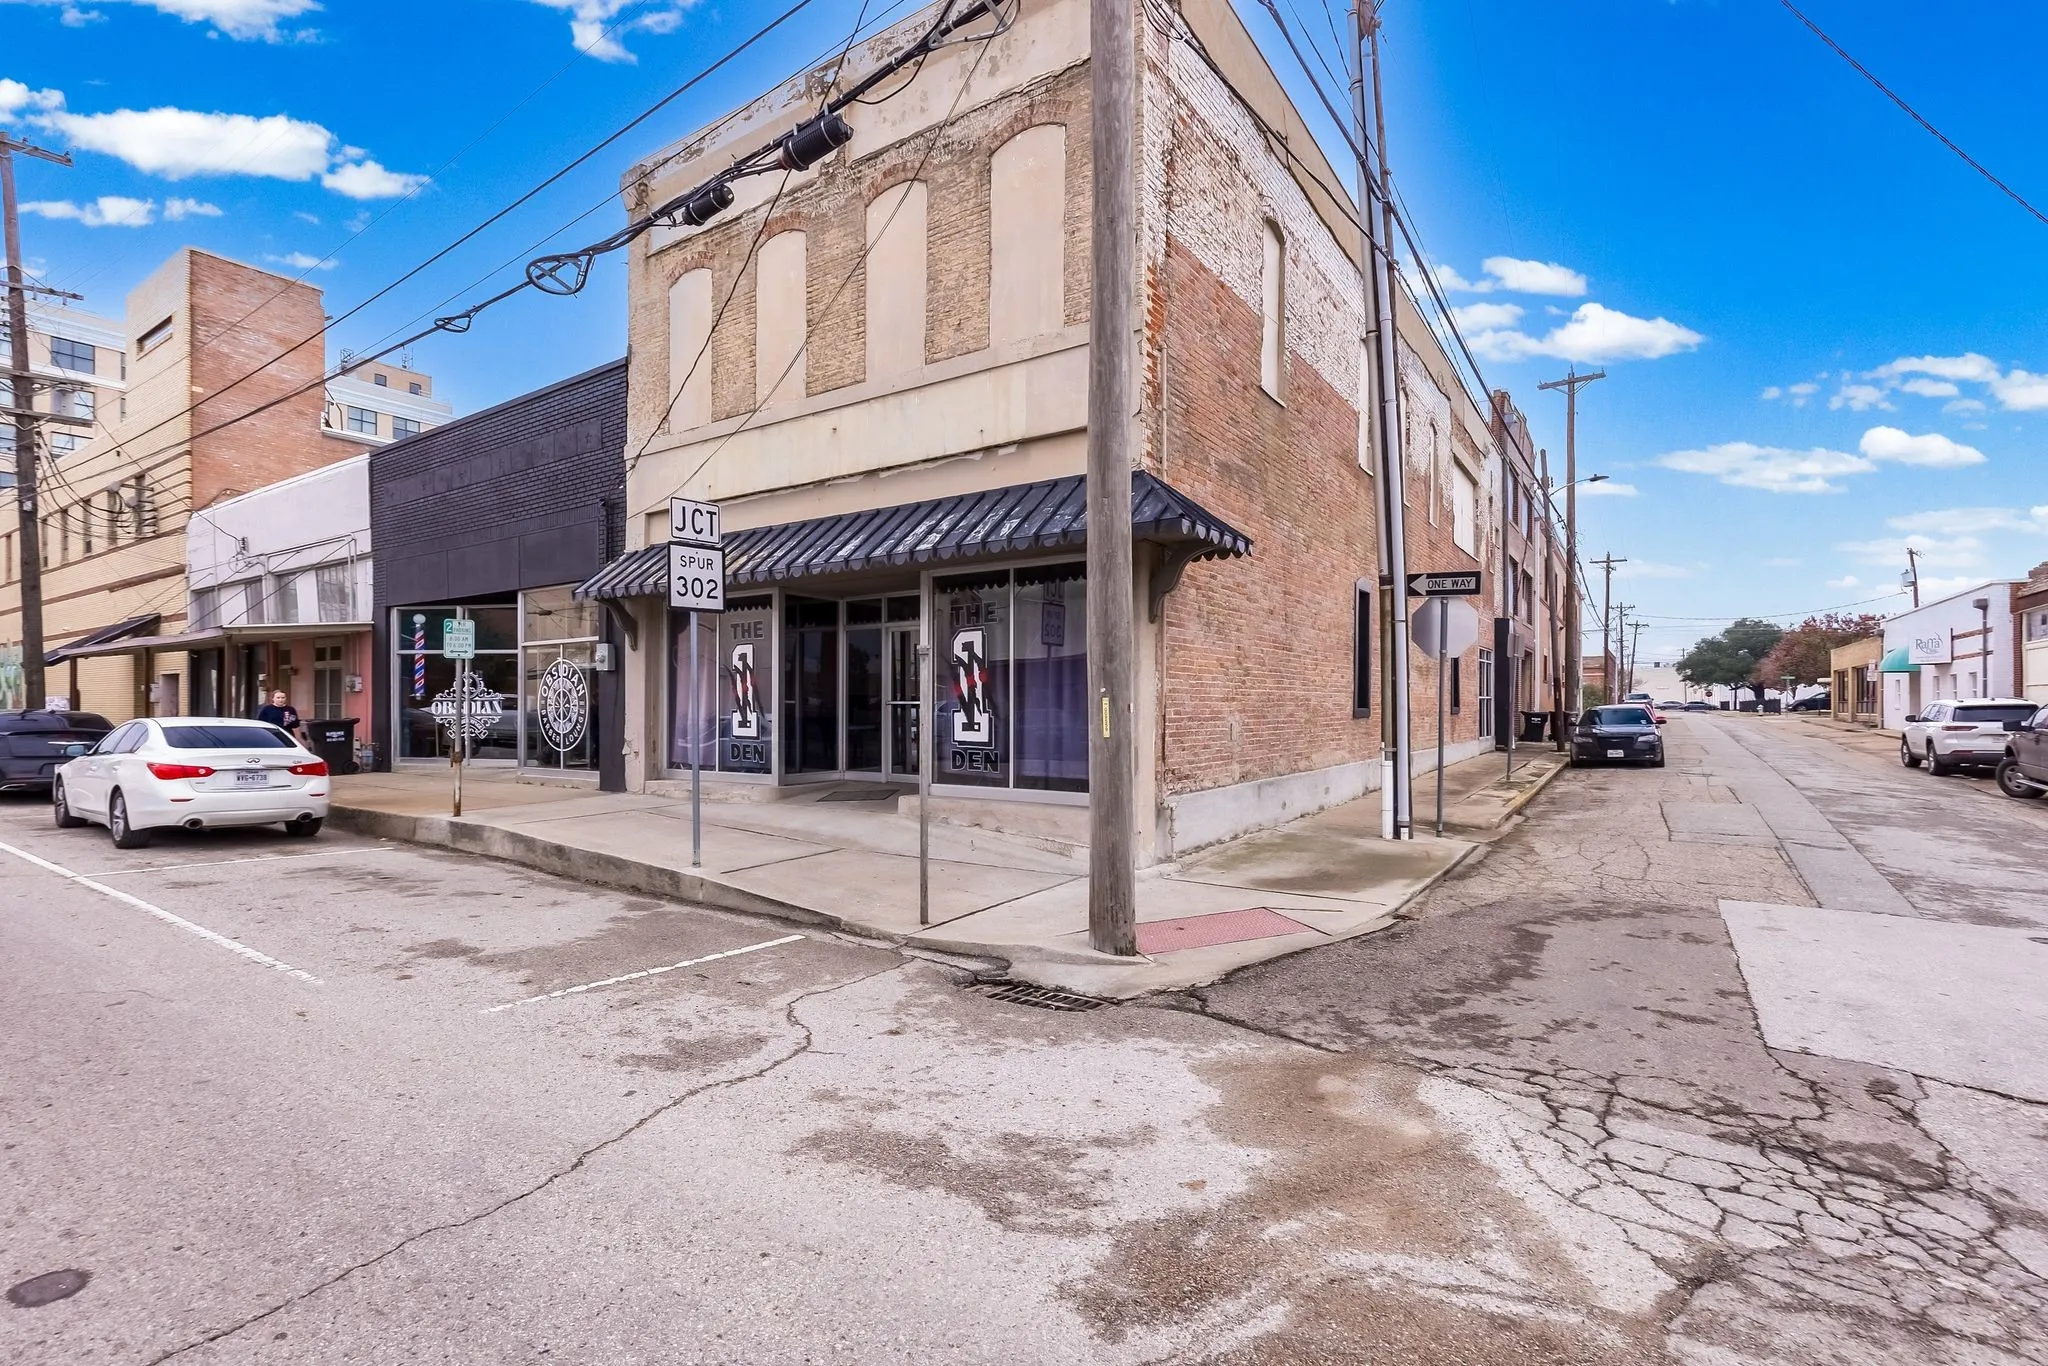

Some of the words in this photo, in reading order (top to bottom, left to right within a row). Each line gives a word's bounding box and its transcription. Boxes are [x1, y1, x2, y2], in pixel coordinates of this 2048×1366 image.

[675, 506, 717, 537] JCT
[680, 555, 714, 571] SPUR
[676, 576, 718, 599] 302
[1427, 579, 1447, 589] ONE
[1451, 578, 1473, 589] WAY
[951, 602, 999, 626] THE
[446, 622, 453, 632] 2
[730, 621, 764, 640] THE
[541, 663, 585, 697] OBSIDIAN
[541, 709, 560, 744] BARBER
[565, 709, 585, 745] LOUNGE
[730, 742, 766, 763] DEN
[951, 750, 1000, 773] DEN
